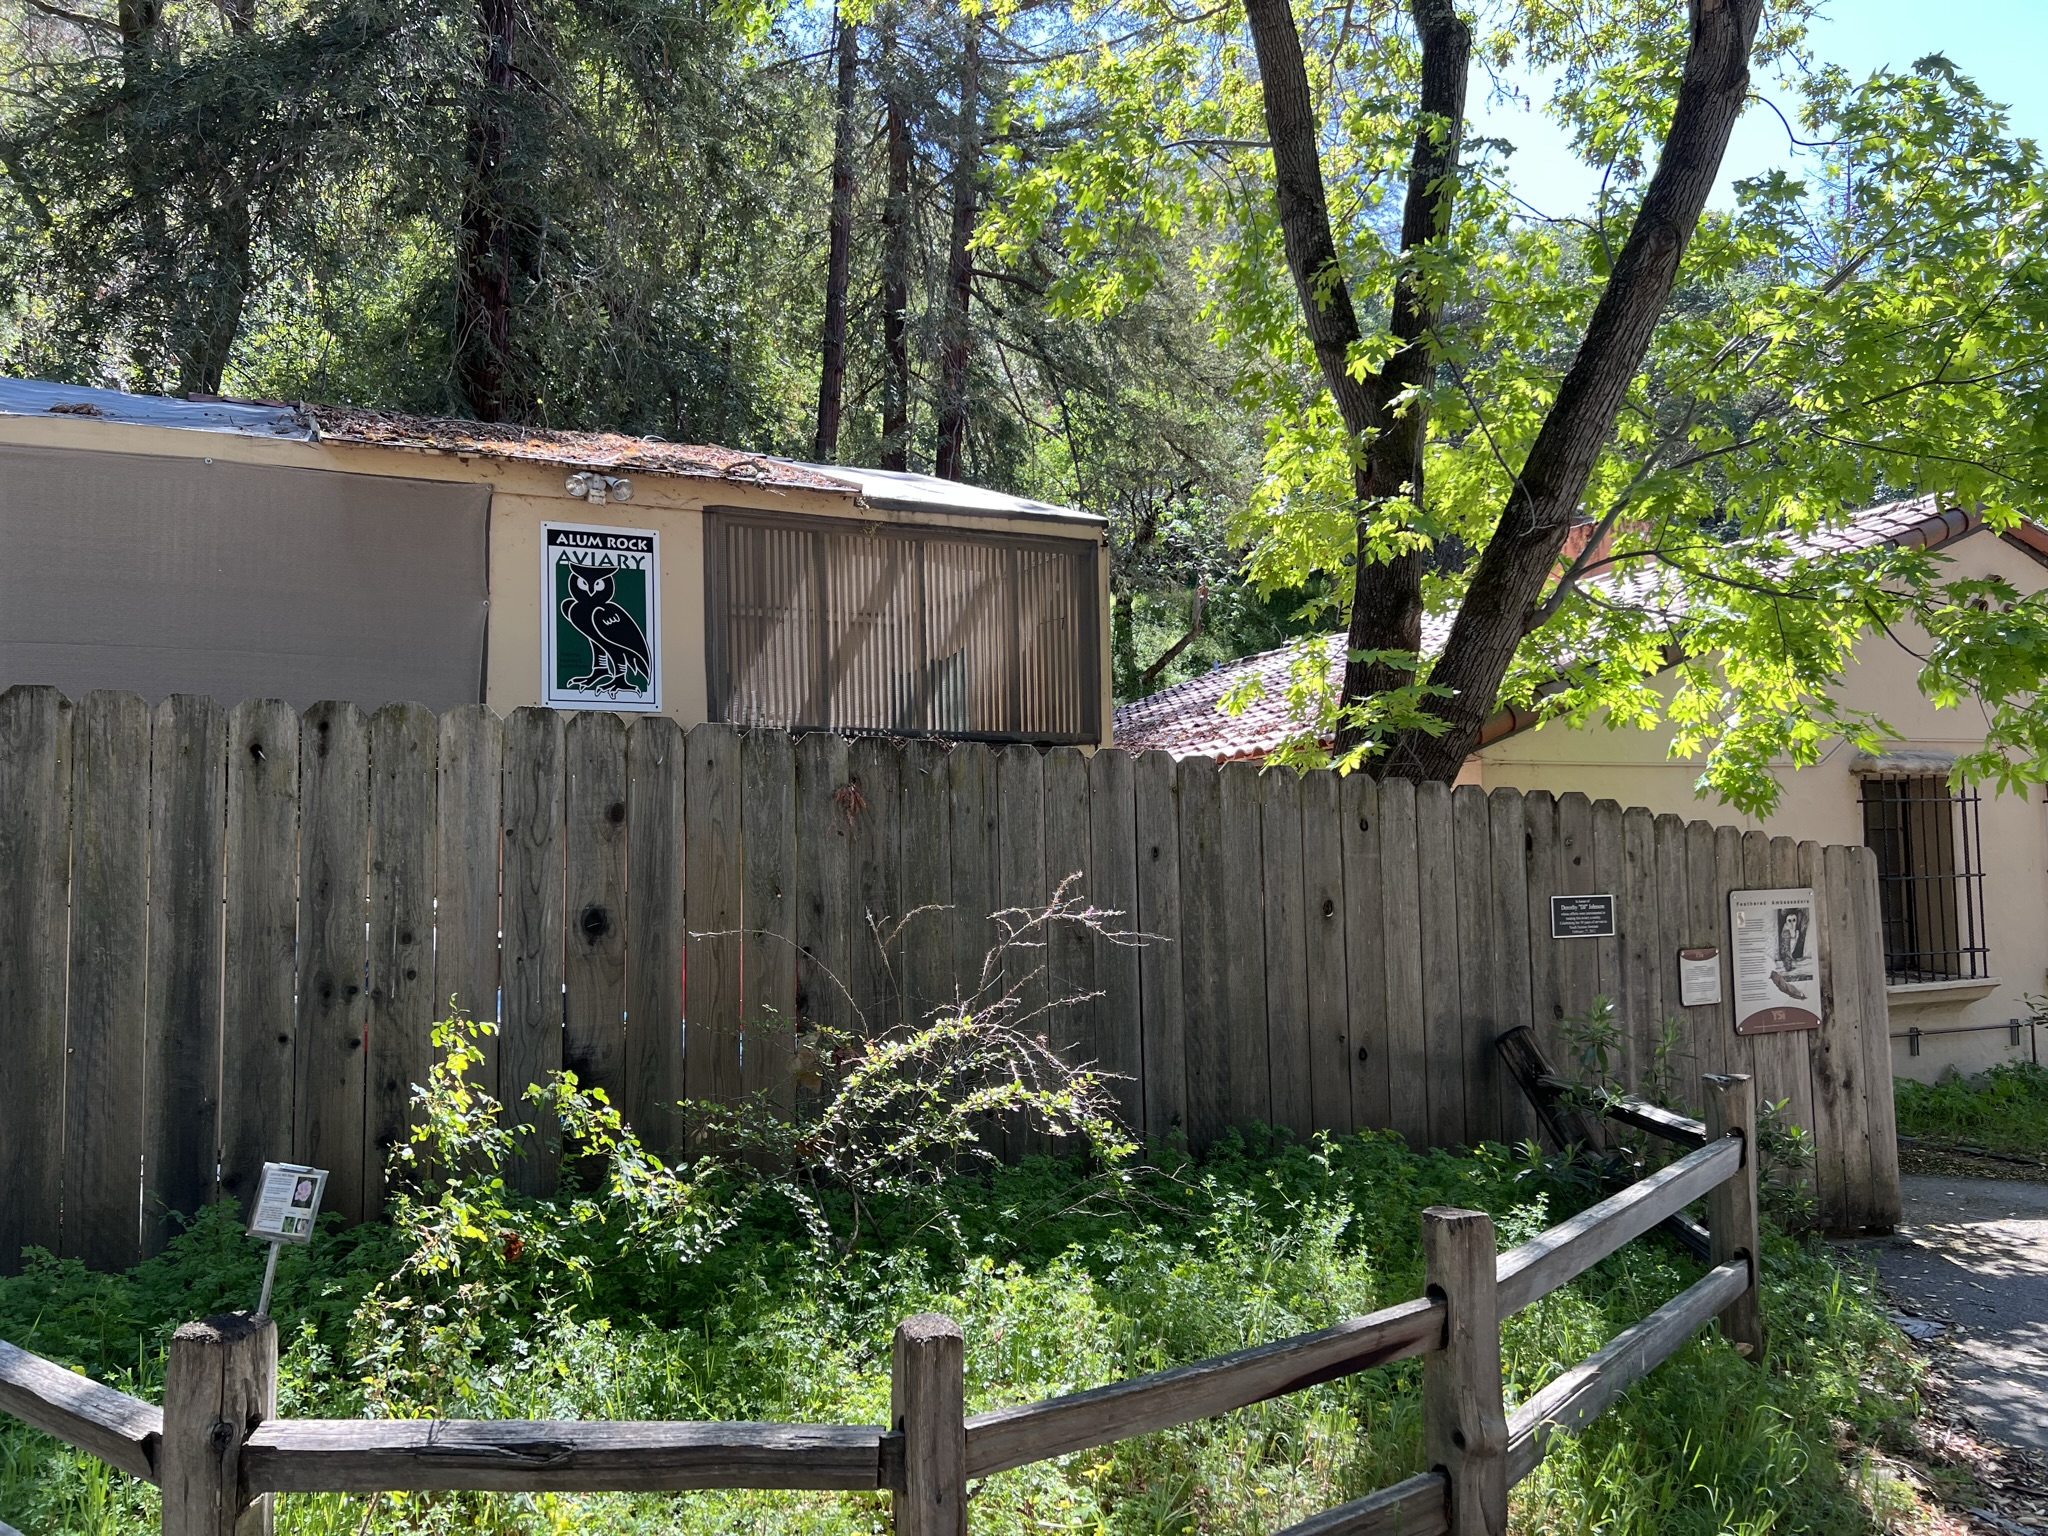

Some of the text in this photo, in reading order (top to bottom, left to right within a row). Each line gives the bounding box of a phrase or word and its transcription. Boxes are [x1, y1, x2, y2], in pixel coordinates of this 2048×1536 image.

[556, 533, 648, 550] ALUM ROCK
[556, 549, 646, 569] AVIARY
